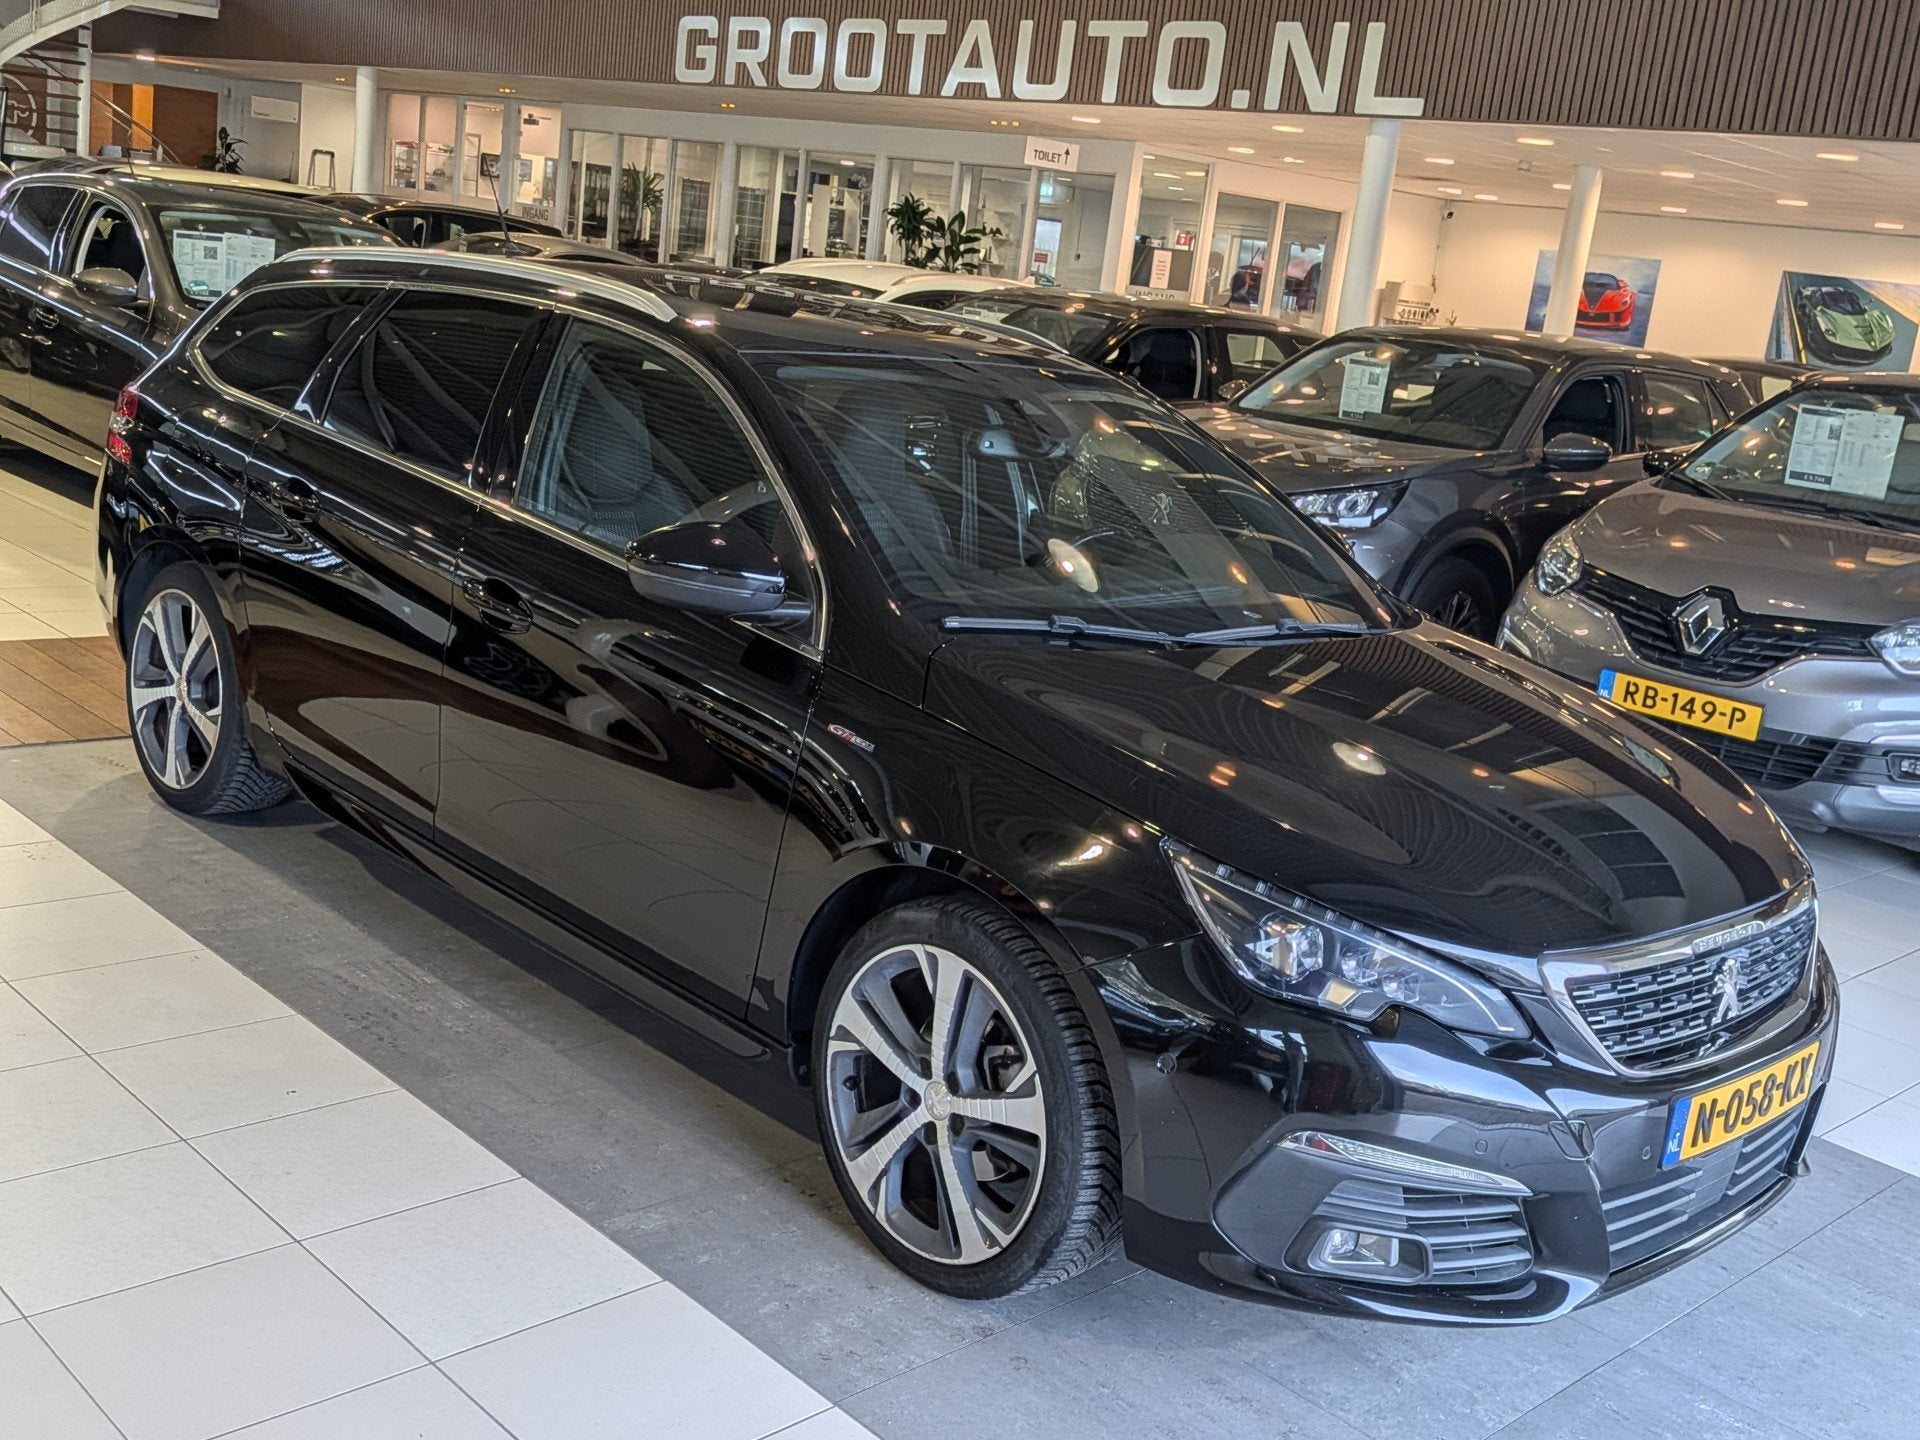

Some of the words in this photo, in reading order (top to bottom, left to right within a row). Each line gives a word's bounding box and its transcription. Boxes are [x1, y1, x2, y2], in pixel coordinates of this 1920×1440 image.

[674, 15, 1425, 117] GROOTAUTO.NL
[1033, 149, 1062, 164] TOILET
[522, 205, 549, 221] INGANG
[1599, 689, 1610, 699] NL
[1622, 680, 1747, 730] RB-149-P
[1667, 1135, 1680, 1155] NL
[1690, 1052, 1814, 1148] N-058-KX
